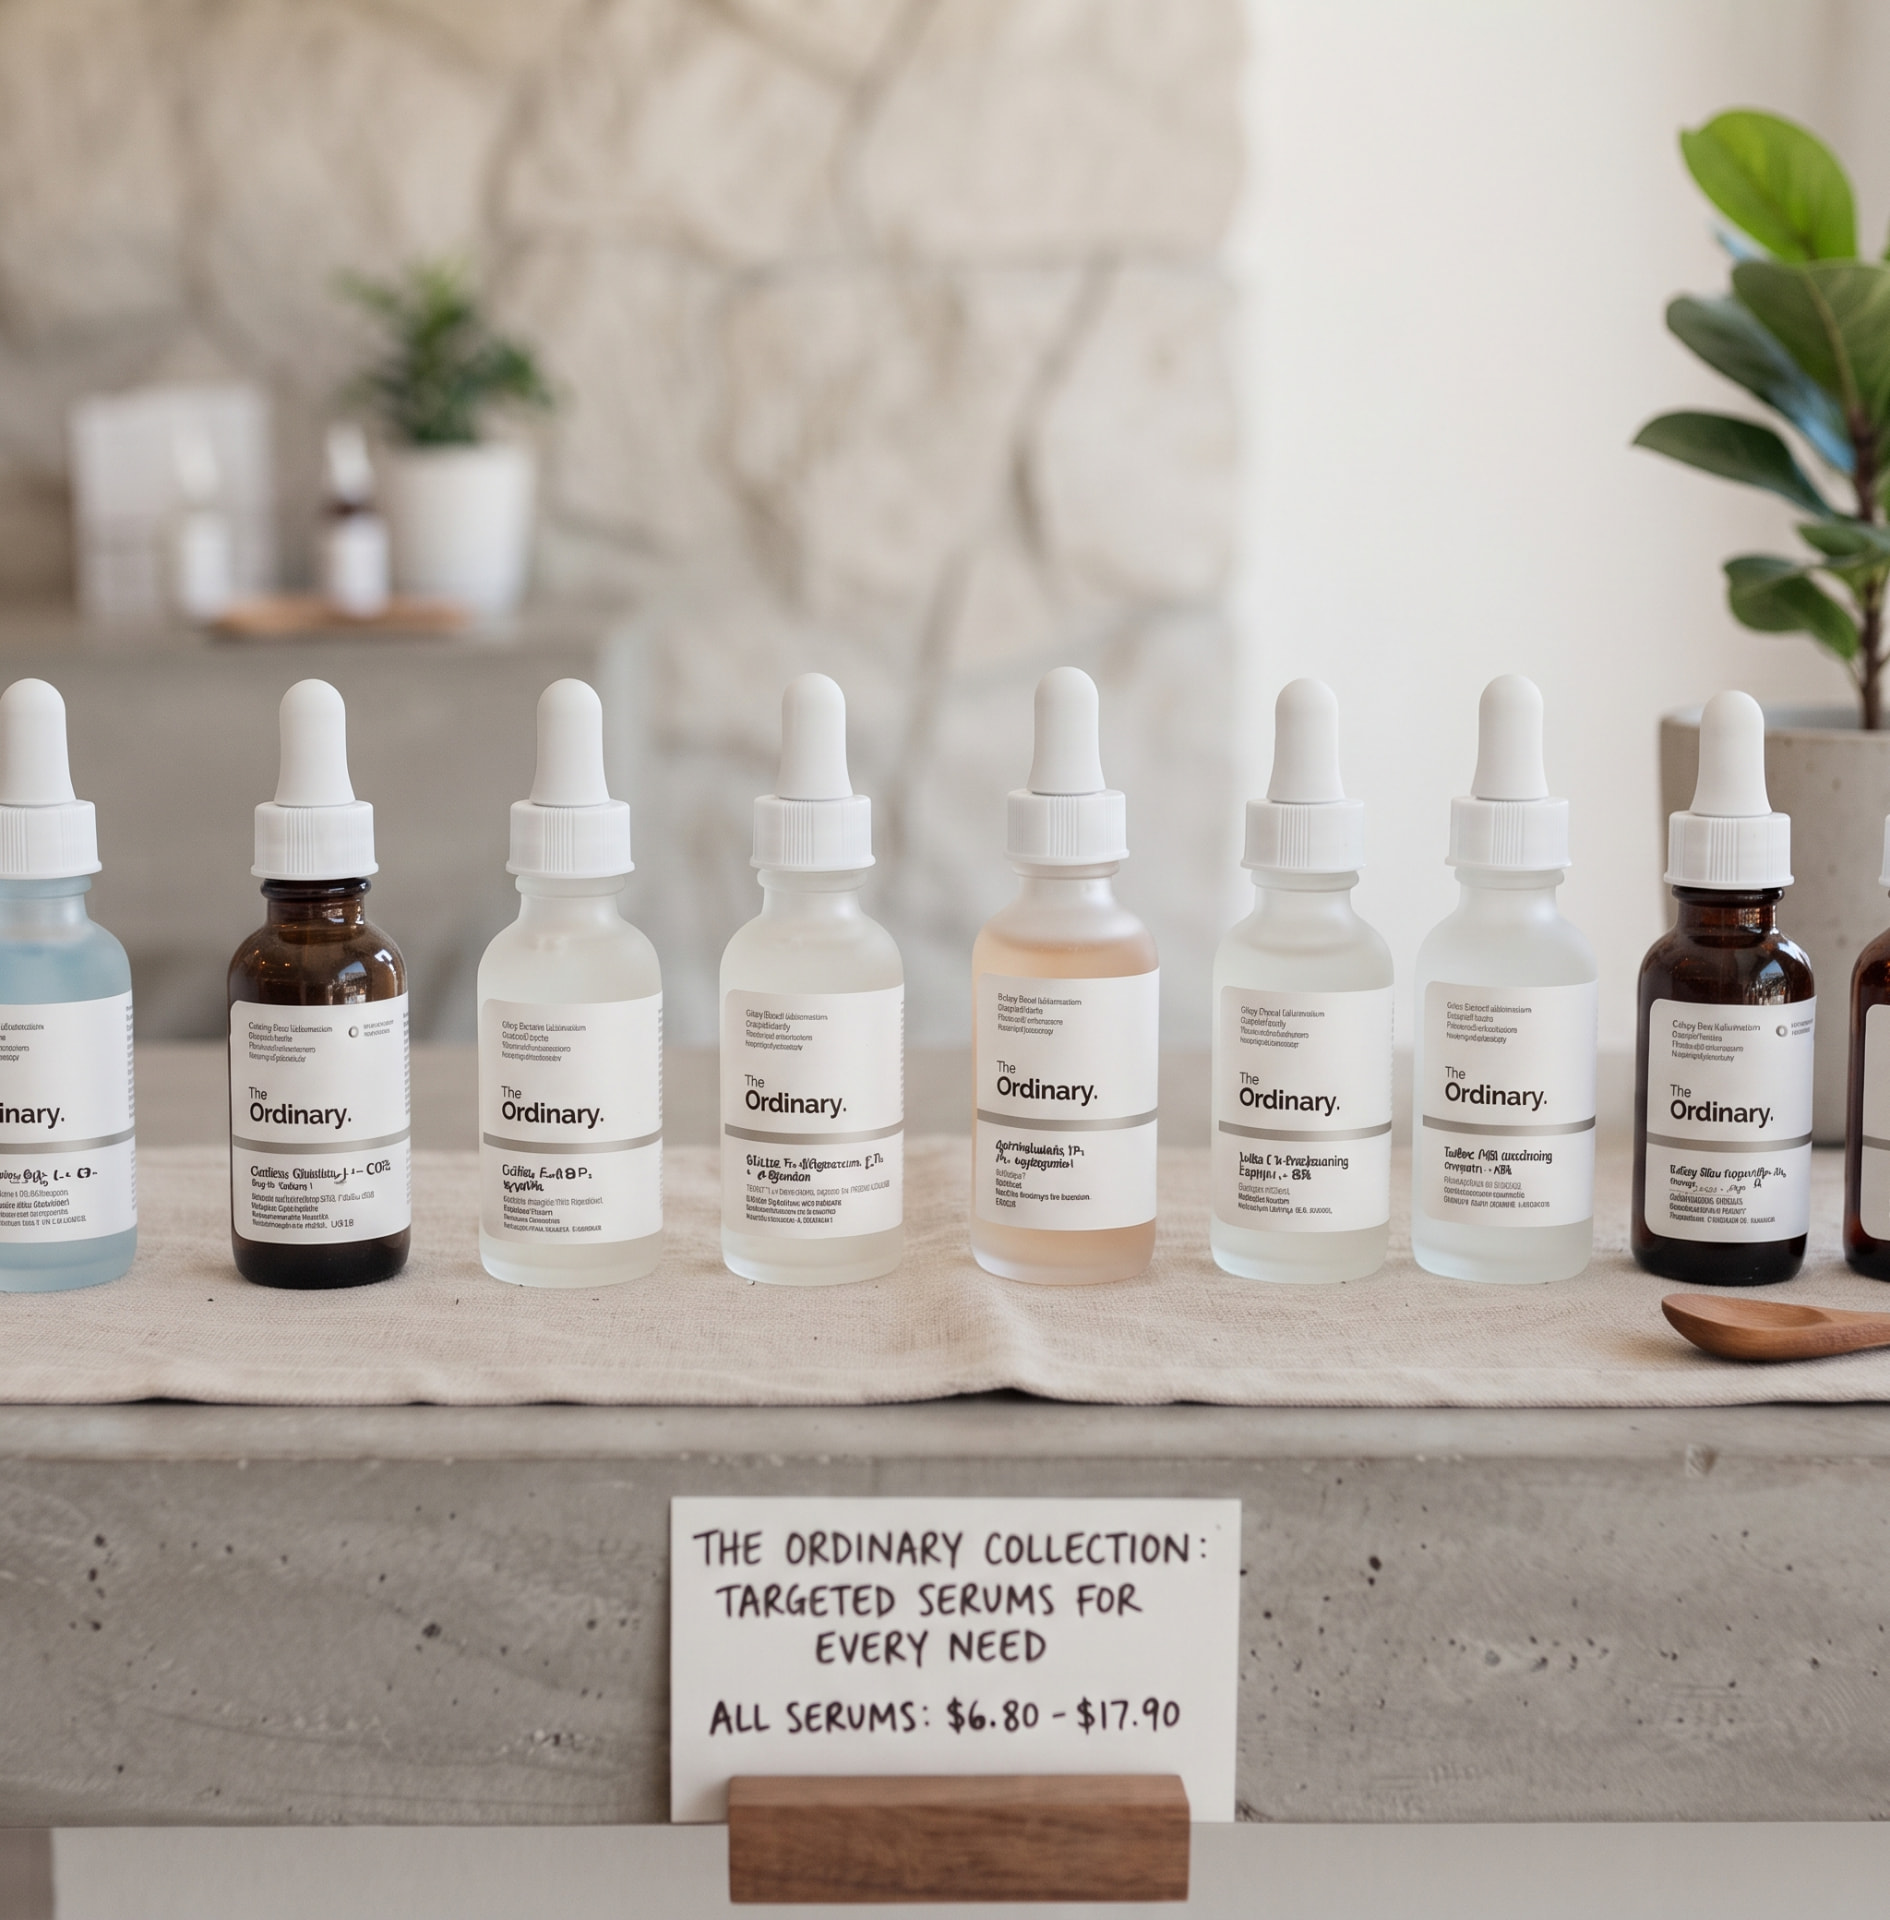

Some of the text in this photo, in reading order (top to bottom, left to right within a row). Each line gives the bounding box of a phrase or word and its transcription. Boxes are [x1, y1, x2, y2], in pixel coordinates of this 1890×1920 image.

[997, 1060, 1016, 1073] The
[1240, 1072, 1259, 1085] The
[1445, 1066, 1465, 1079] The
[249, 1087, 267, 1100] The
[501, 1086, 522, 1099] The
[745, 1074, 764, 1088] The
[997, 1076, 1097, 1106] Ordinary.
[1670, 1084, 1691, 1097] The
[745, 1090, 846, 1119] Ordinary.
[1239, 1087, 1339, 1116] Ordinary.
[1445, 1082, 1547, 1111] Ordinary.
[0, 1102, 64, 1129] inary.
[250, 1102, 351, 1129] Ordinary.
[502, 1101, 604, 1129] Ordinary.
[1670, 1099, 1773, 1128] Ordinary.
[692, 1529, 1206, 1569] THE ORDINARY COLLECTION:
[715, 1582, 1142, 1618] TARGETED SERUMS FOR
[816, 1629, 1046, 1668] EVERY NEED
[709, 1700, 770, 1736] ALL
[786, 1701, 929, 1734] SERUMS:
[947, 1697, 1039, 1734] $6.80
[1077, 1697, 1180, 1735] $17.90
